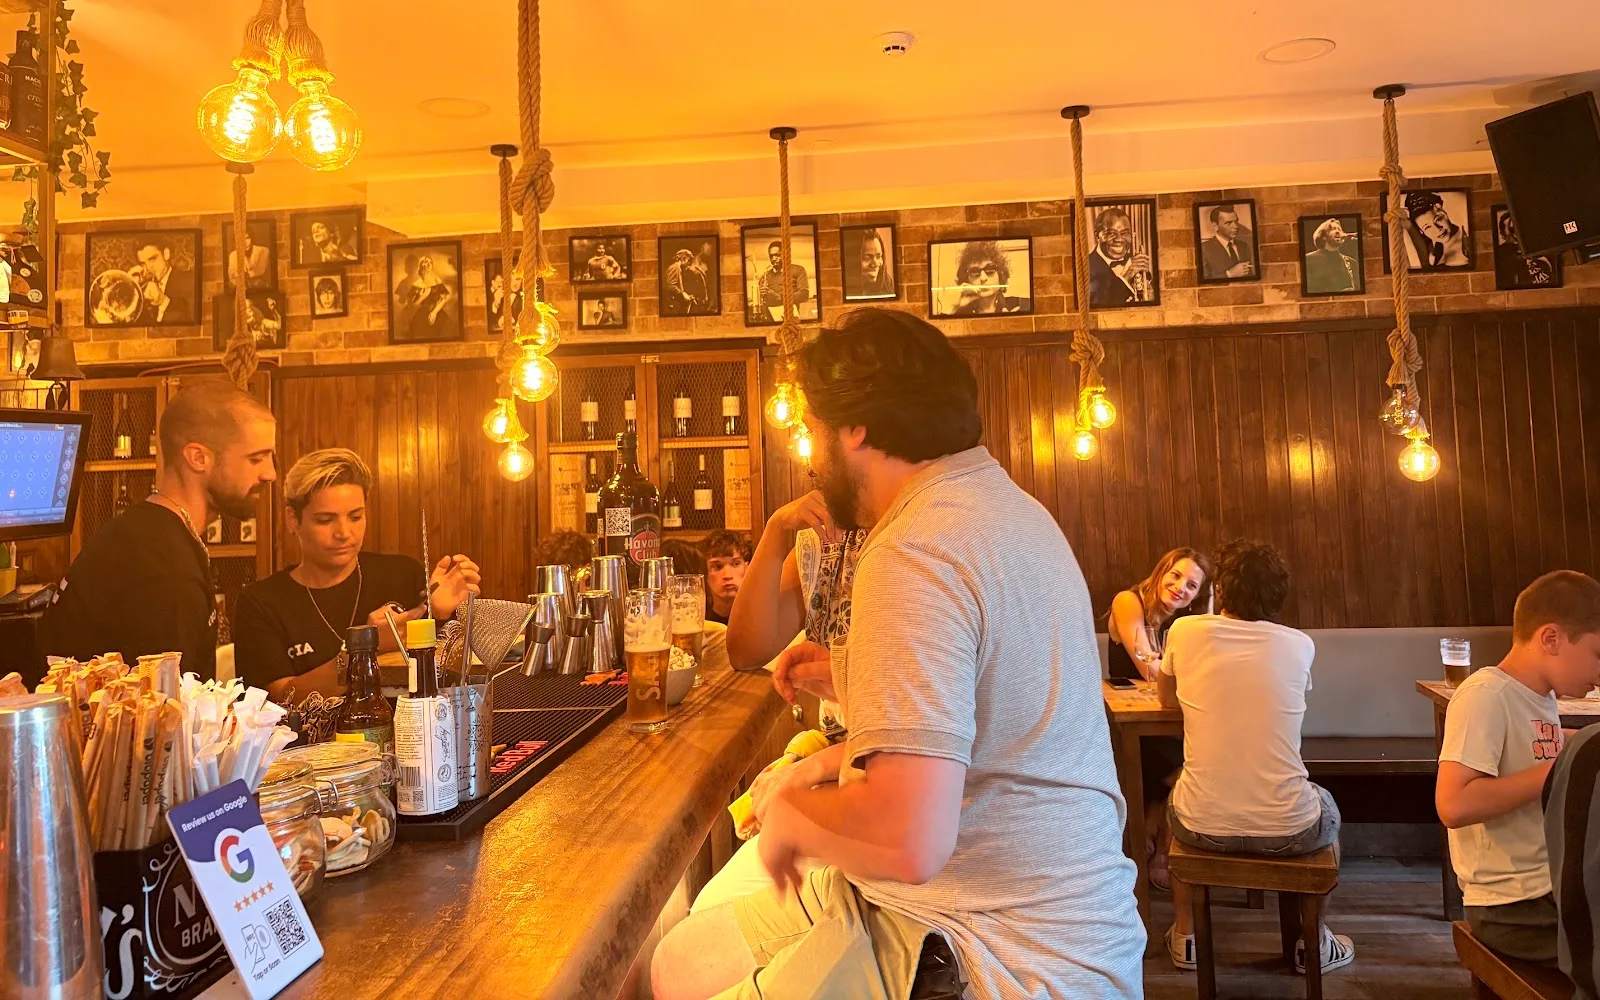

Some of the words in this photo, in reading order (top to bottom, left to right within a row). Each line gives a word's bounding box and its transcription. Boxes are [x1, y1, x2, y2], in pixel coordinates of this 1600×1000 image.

[181, 816, 207, 832] Review
[206, 811, 216, 821] us
[215, 807, 225, 817] on
[223, 795, 248, 812] Google
[181, 915, 218, 948] BRA
[253, 971, 264, 981] Tap
[268, 959, 281, 971] Scan
